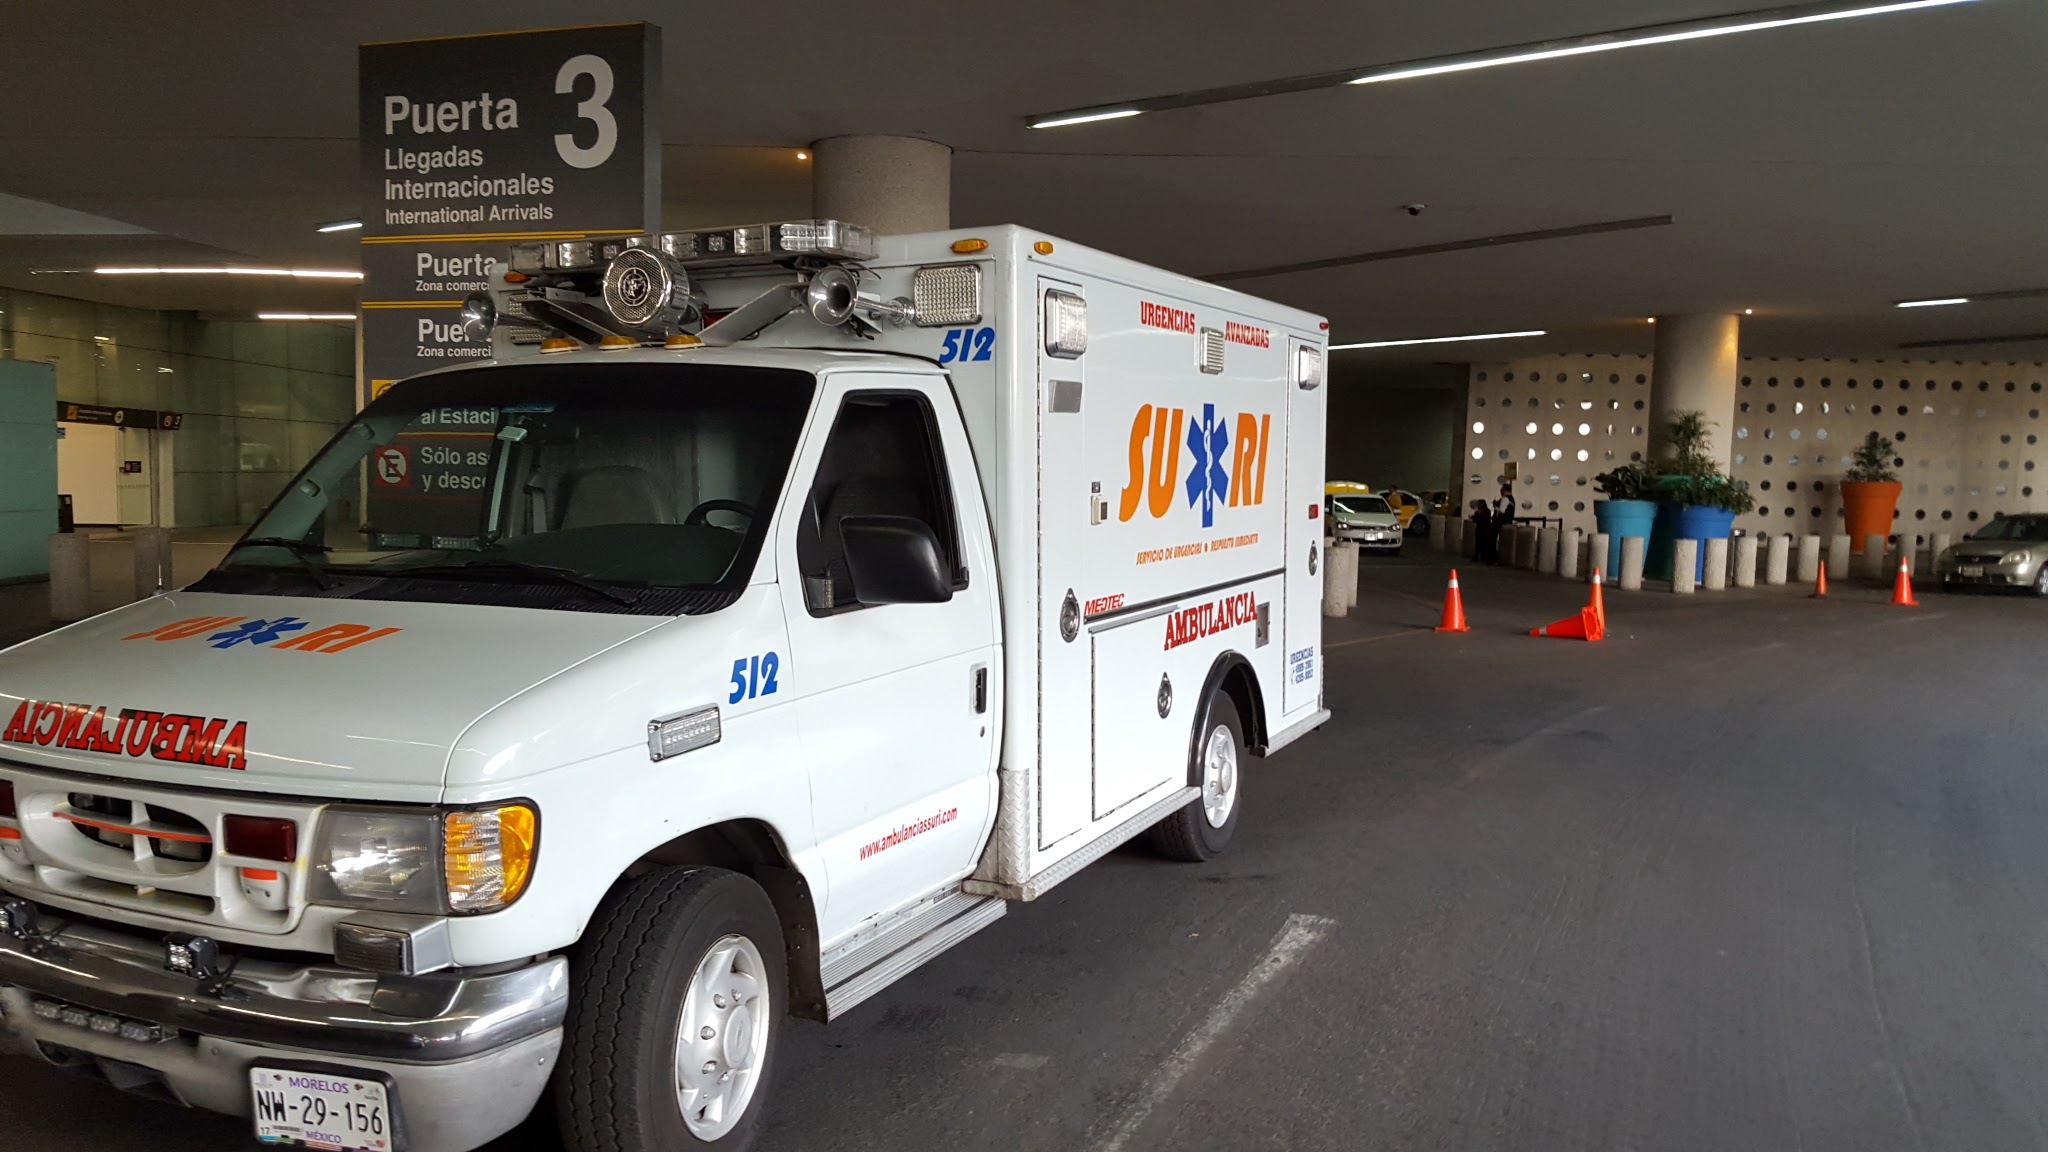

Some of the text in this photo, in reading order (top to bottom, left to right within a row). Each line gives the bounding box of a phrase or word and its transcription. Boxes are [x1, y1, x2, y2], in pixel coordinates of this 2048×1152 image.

[385, 93, 519, 135] Puerta
[554, 54, 618, 169] 3
[385, 146, 484, 175] Llegadas
[385, 173, 554, 200] Internacionales
[385, 203, 553, 225] International Arrivals
[415, 280, 444, 291] Zona
[1140, 301, 1270, 349] URGENCIAS AVANZADAS
[417, 346, 444, 357] Zona
[938, 326, 996, 364] 512
[421, 407, 495, 424] al Estaci
[421, 446, 491, 465] Sólo as
[421, 474, 432, 492] y
[1135, 548, 1164, 566] SERVICIO
[1165, 546, 1173, 560] DE
[1084, 593, 1125, 615] MEDTEC
[1164, 591, 1258, 651] AMBULANCIA
[729, 651, 779, 705] 512
[859, 807, 958, 861] www.ambulanciassuri.com
[288, 1076, 350, 1094] MORELOS
[305, 1129, 342, 1144] MÉXICO
